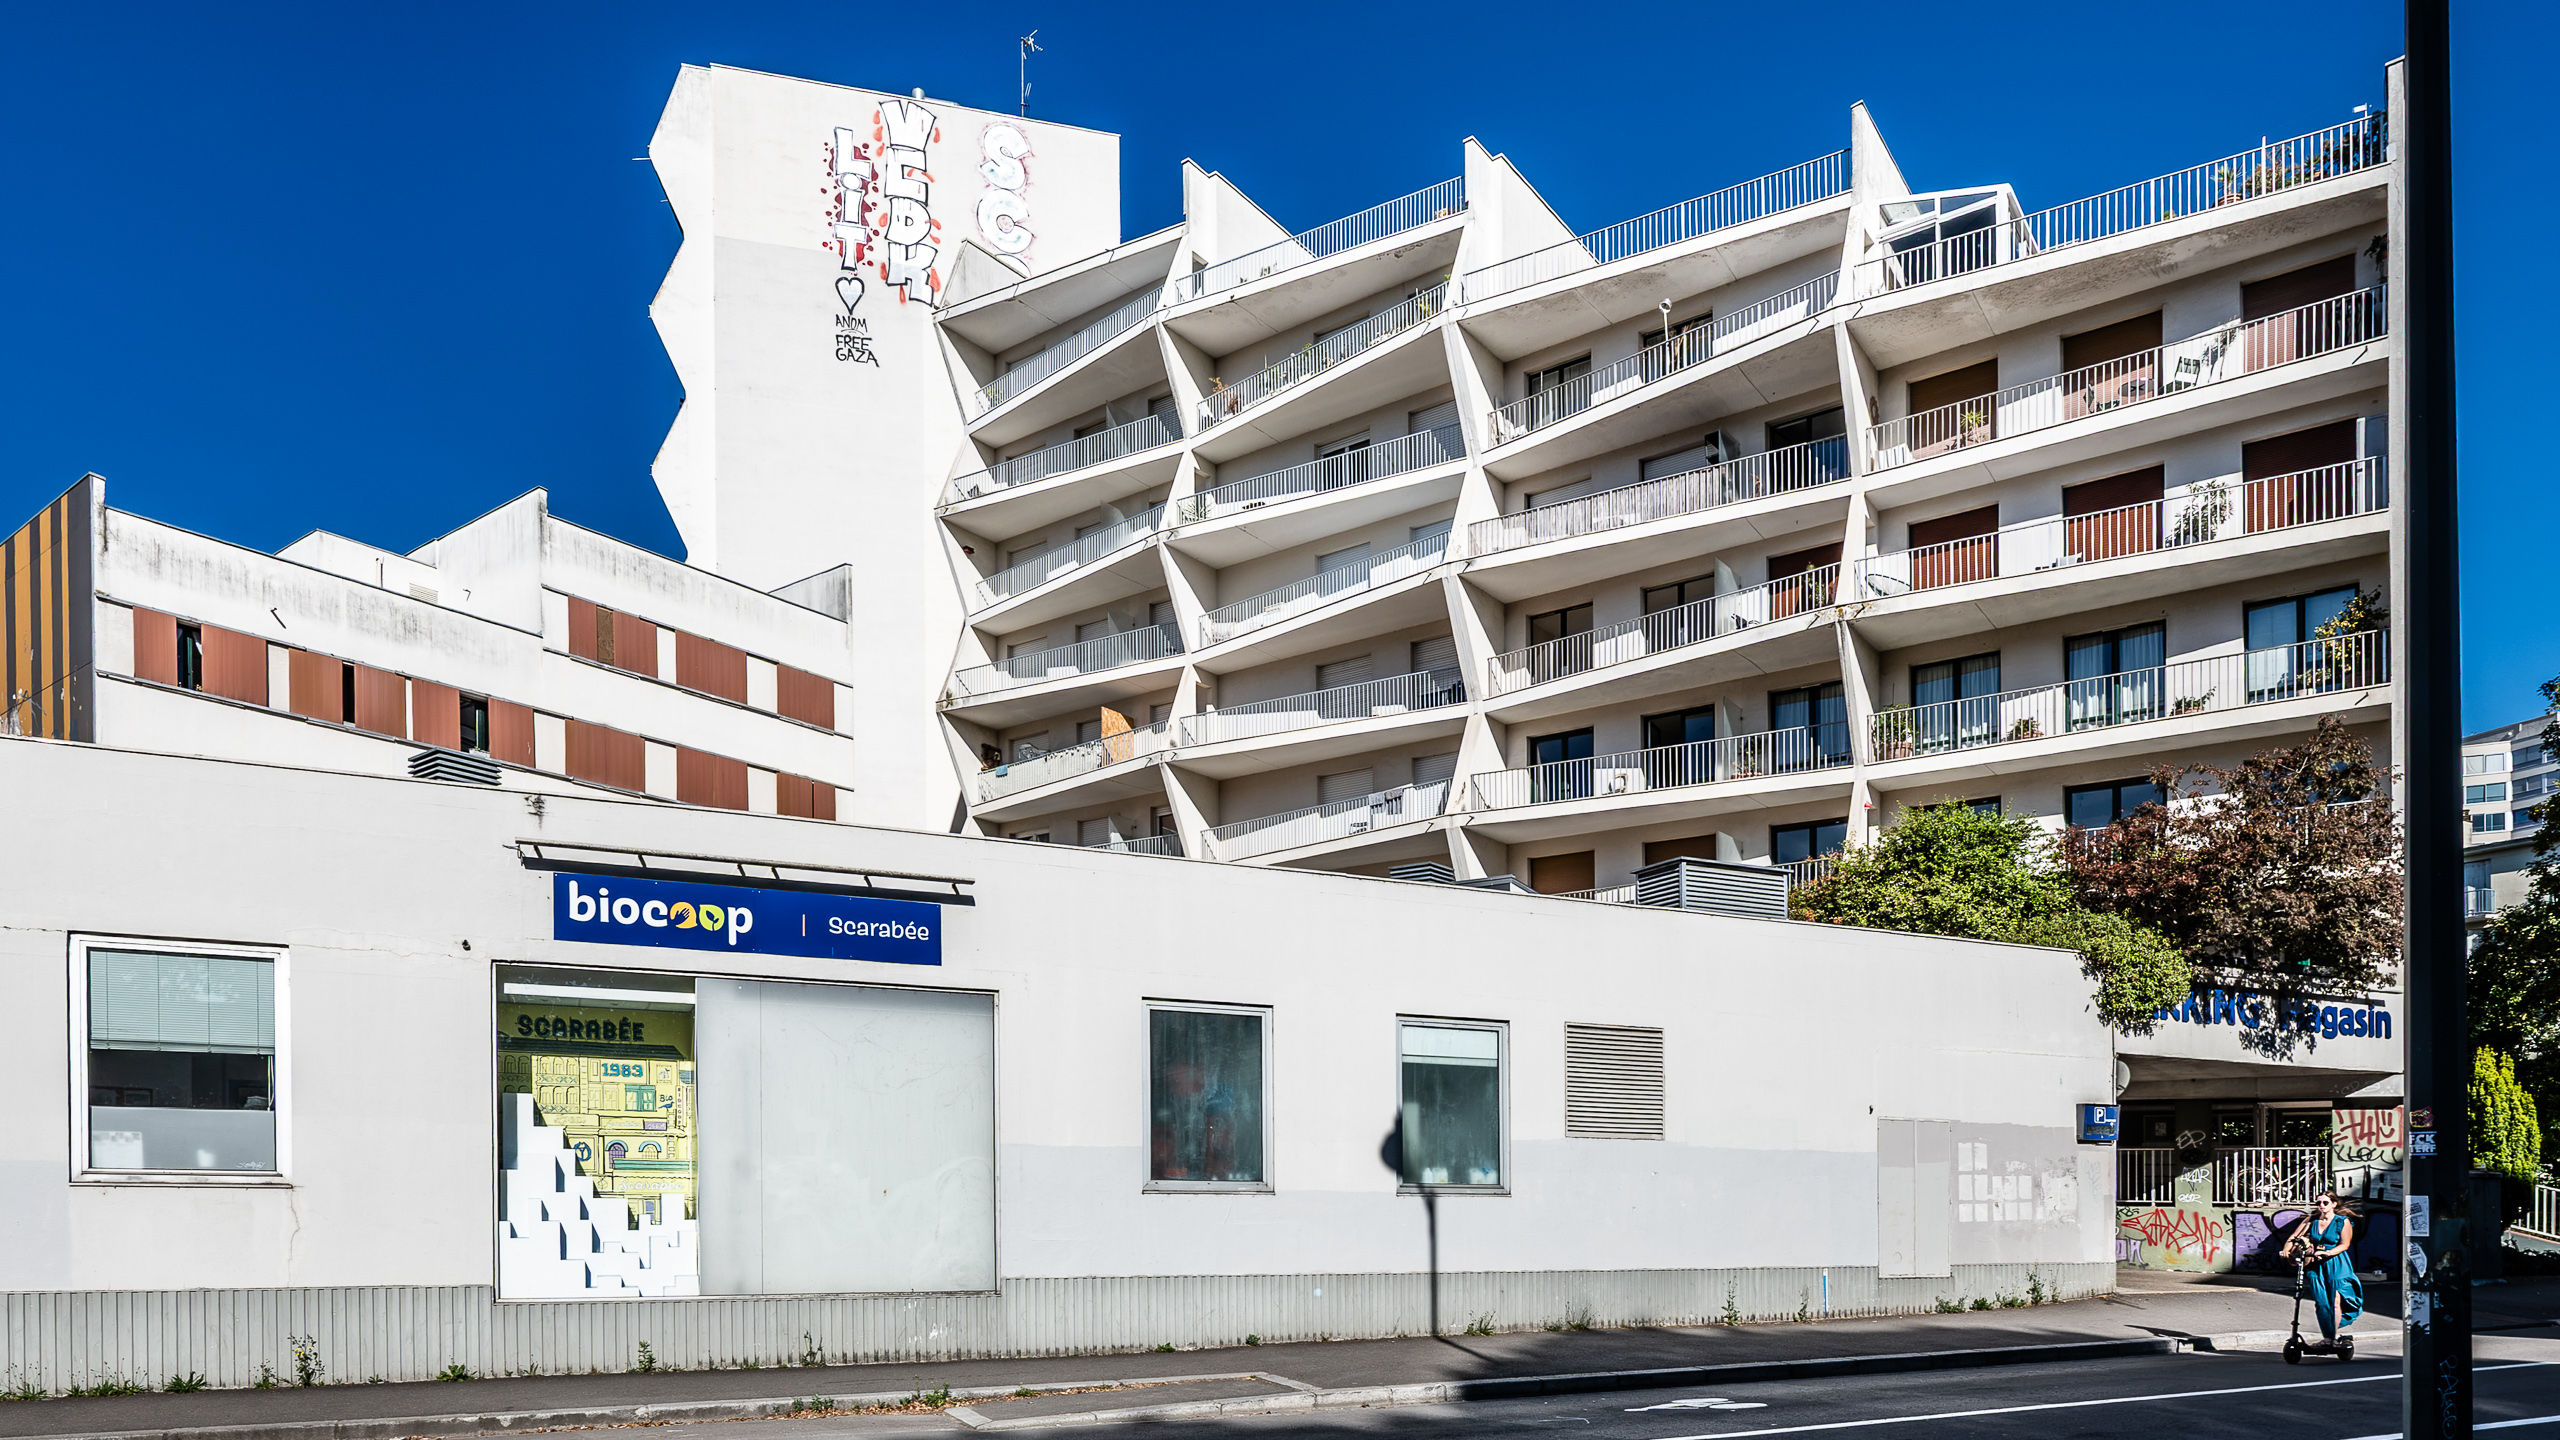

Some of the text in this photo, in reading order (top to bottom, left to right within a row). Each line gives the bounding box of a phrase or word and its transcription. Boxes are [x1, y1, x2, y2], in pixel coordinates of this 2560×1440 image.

[975, 123, 1034, 279] SC
[835, 334, 873, 351] FREE
[835, 347, 880, 368] GAZA
[568, 880, 930, 946] biocoop Scarabée
[516, 1013, 645, 1042] SCARABÉE
[602, 1062, 643, 1078] 1983
[2096, 1108, 2105, 1122] P
